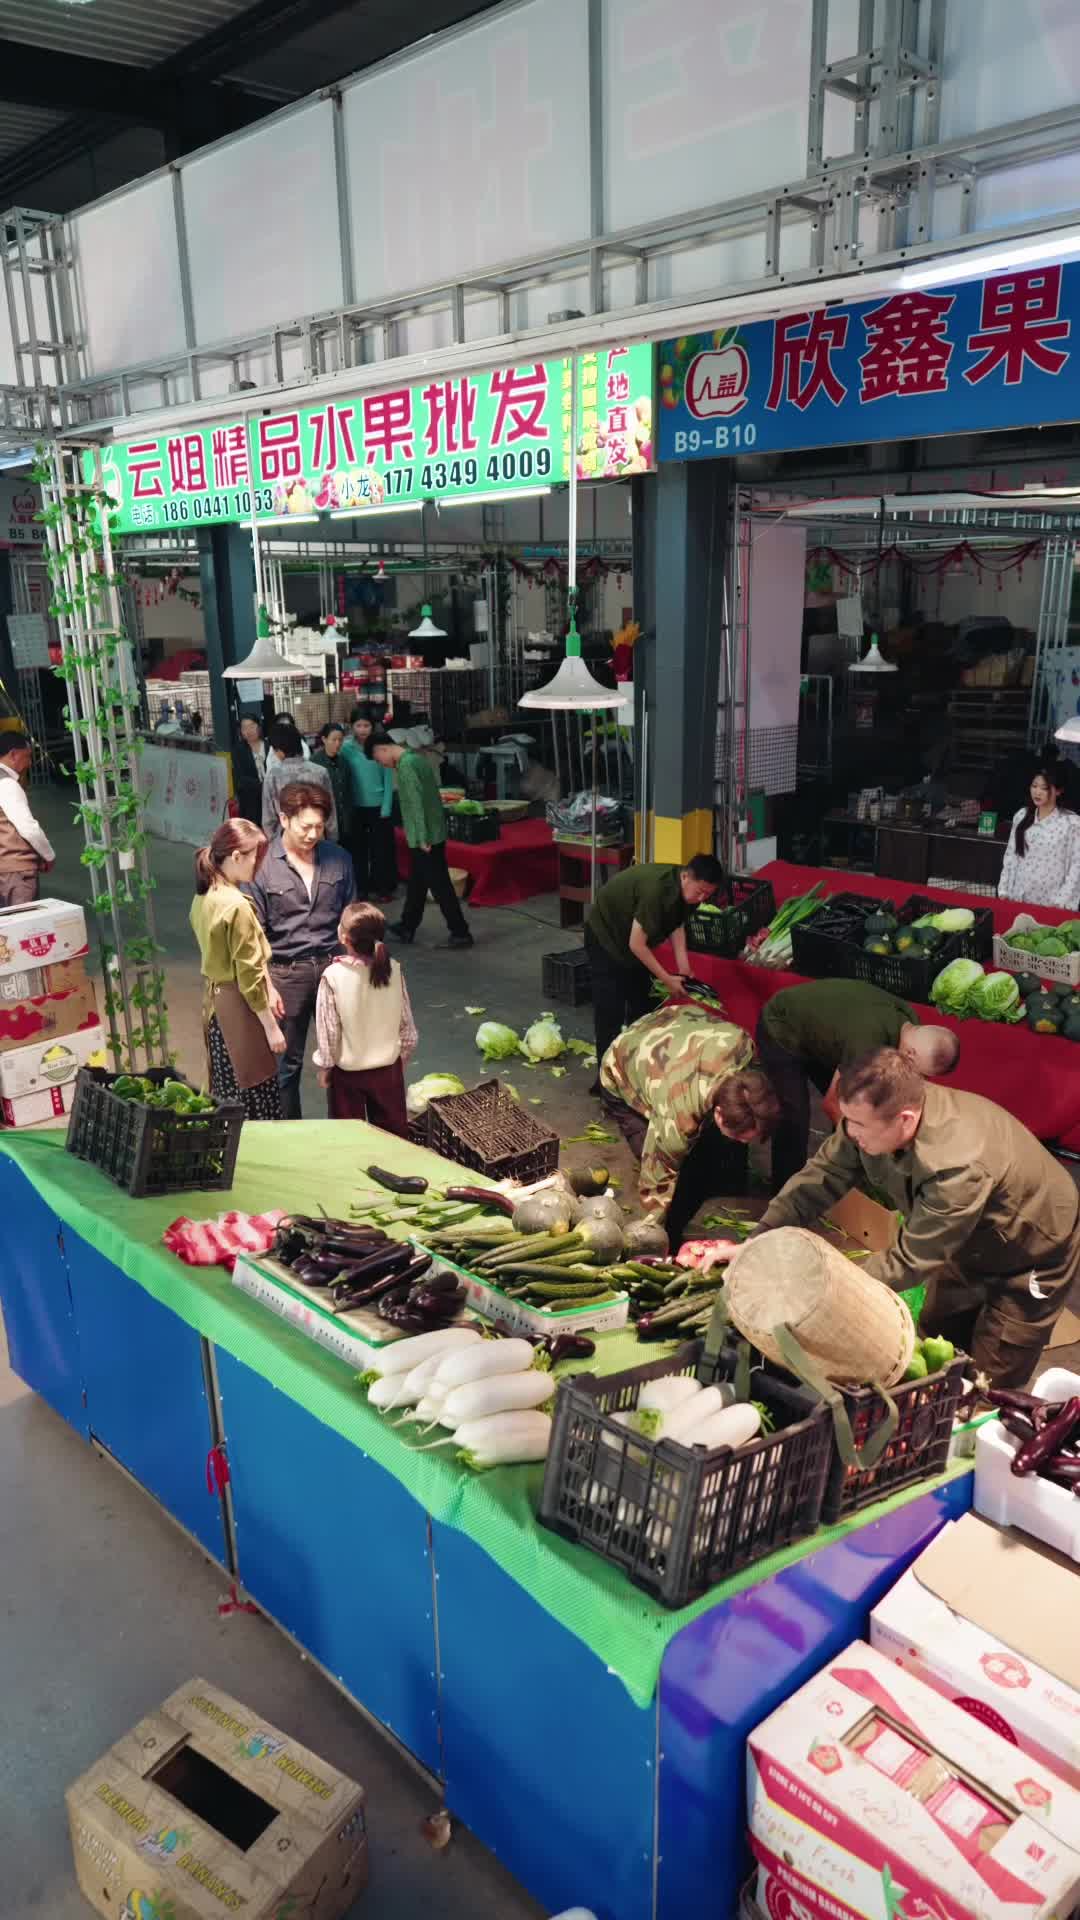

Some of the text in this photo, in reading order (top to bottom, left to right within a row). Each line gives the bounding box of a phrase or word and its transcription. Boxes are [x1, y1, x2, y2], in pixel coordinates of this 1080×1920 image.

[764, 265, 1071, 413] 欣鑫果
[127, 362, 551, 500] 云姐精品水果批发
[674, 423, 757, 453] B9-B10
[383, 467, 413, 496] 177
[421, 457, 478, 491] 4349
[486, 446, 552, 483] 4009
[163, 499, 189, 522] 186
[193, 495, 230, 519] 0441
[234, 488, 273, 514] 1053
